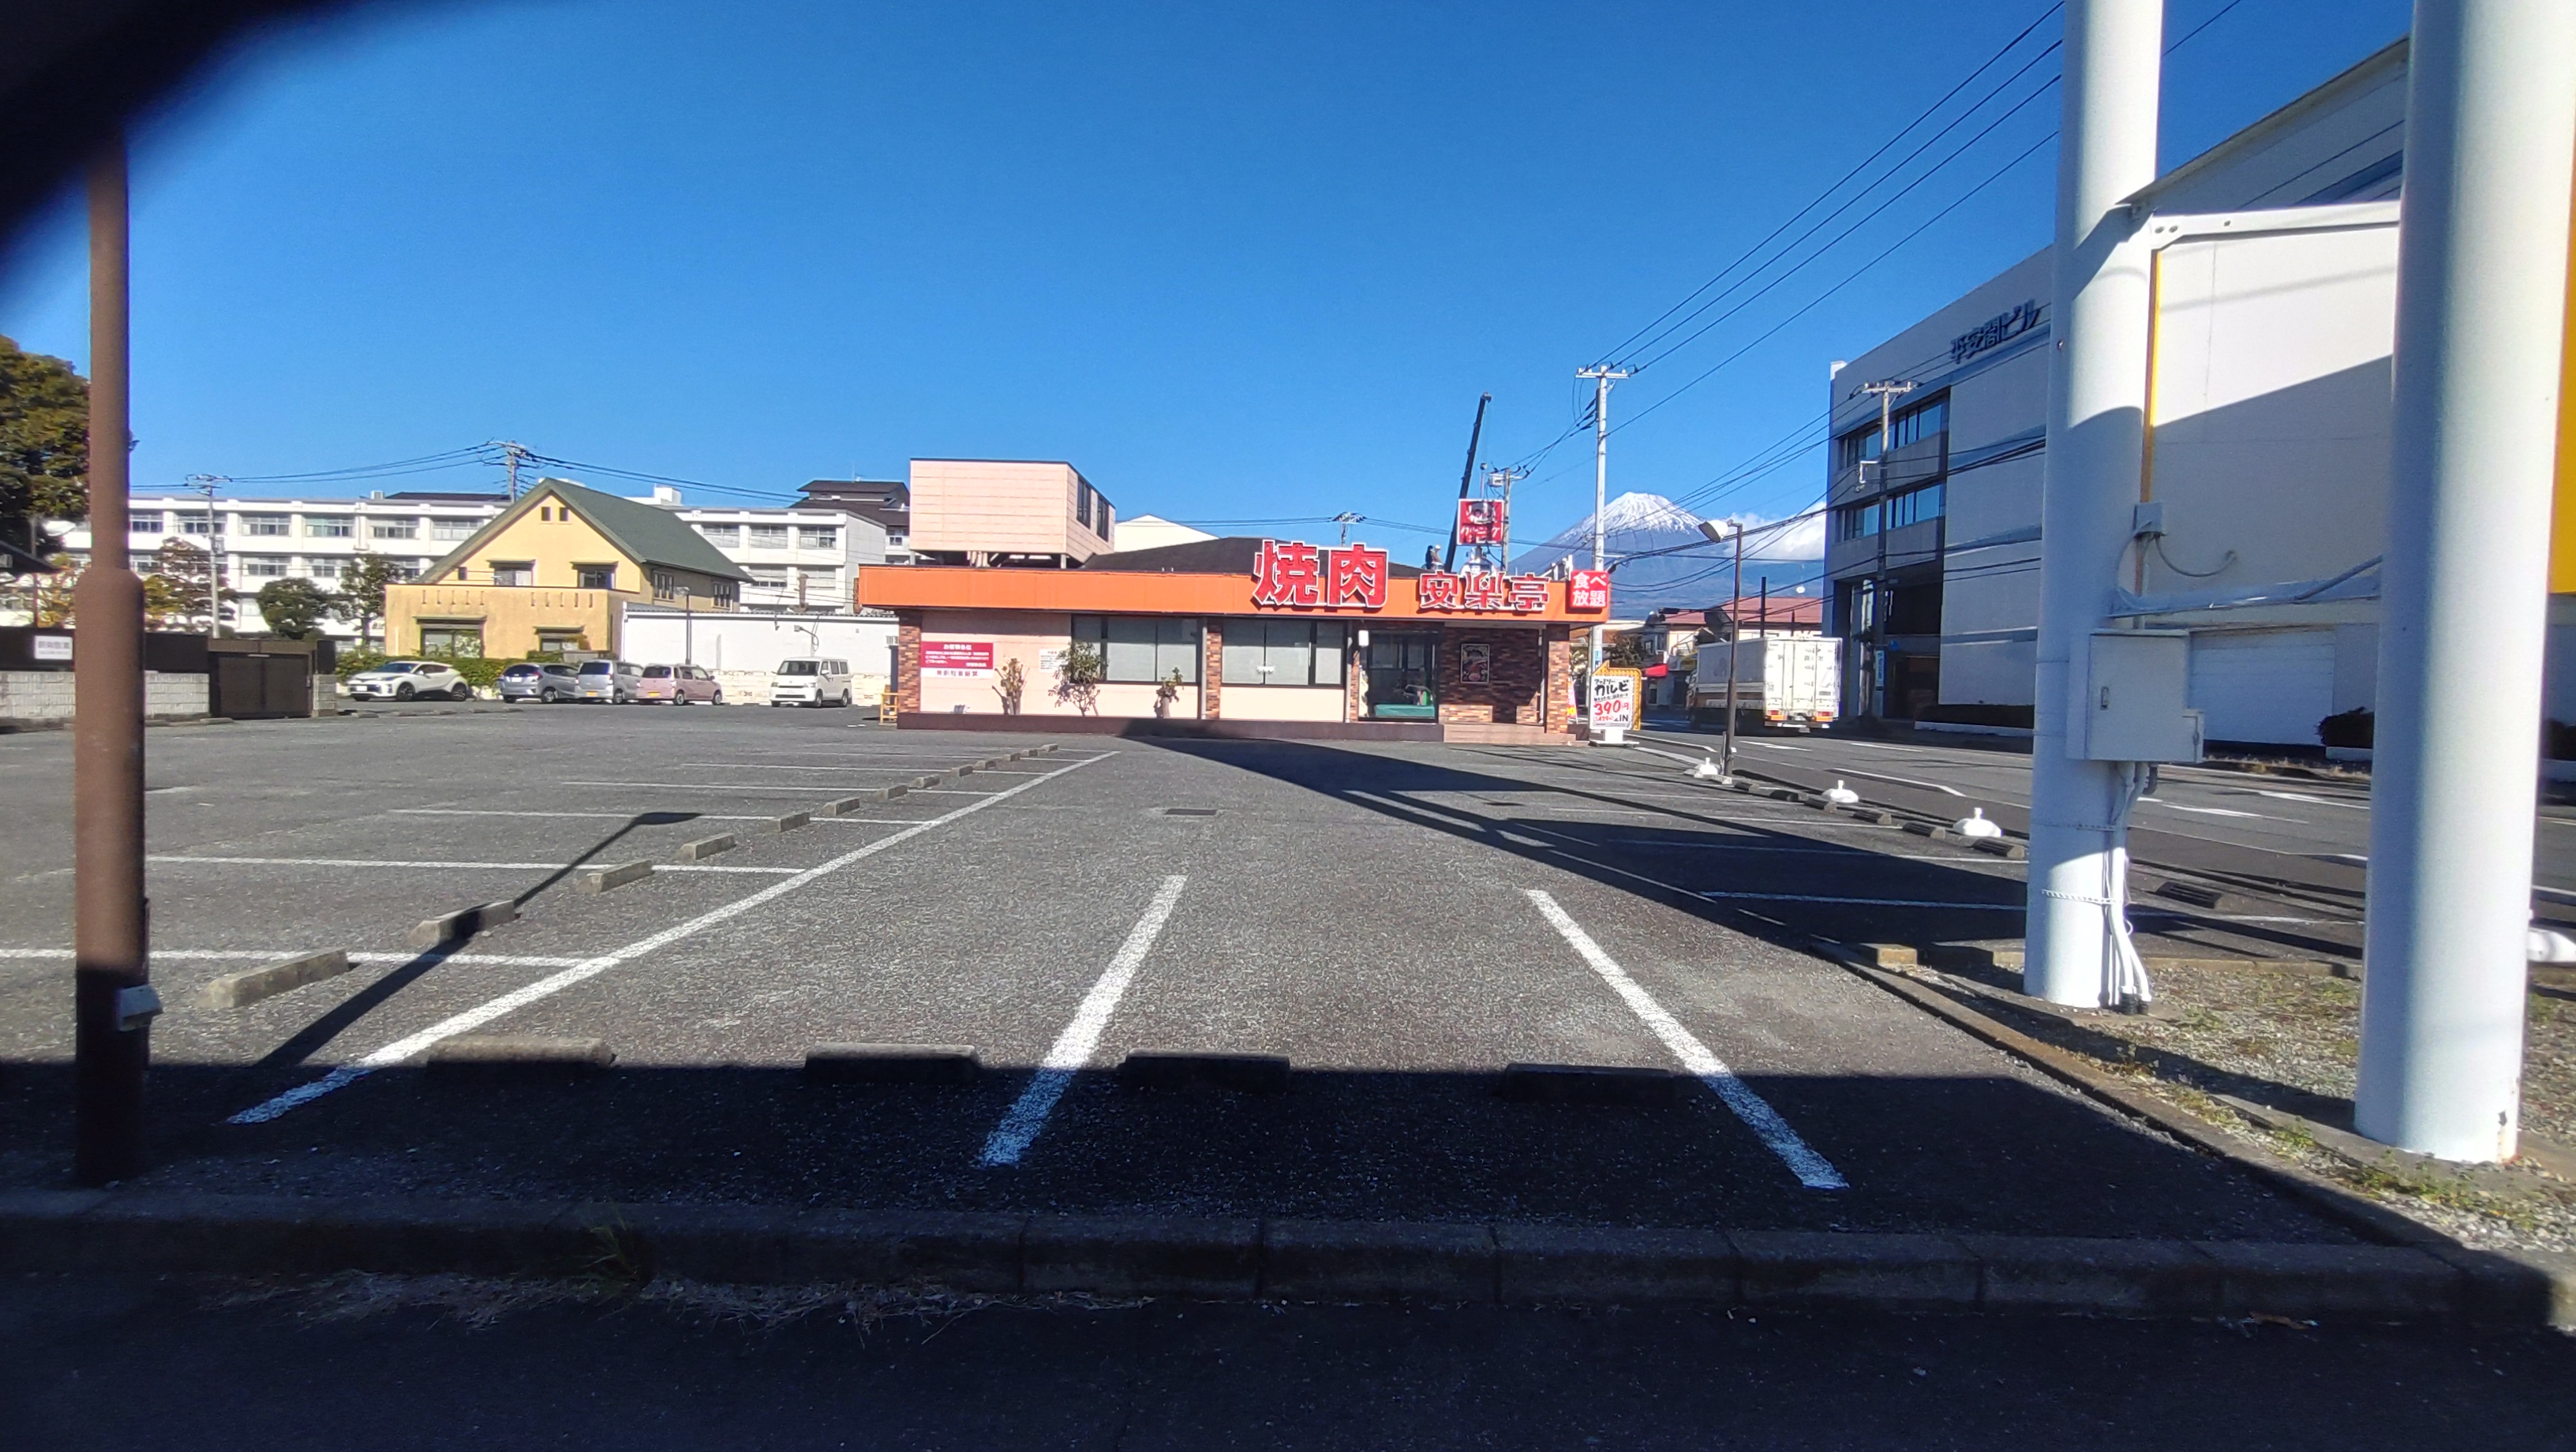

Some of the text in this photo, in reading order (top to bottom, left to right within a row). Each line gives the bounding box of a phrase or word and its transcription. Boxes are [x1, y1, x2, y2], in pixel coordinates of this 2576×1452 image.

[1252, 540, 1389, 608] 焼肉
[1573, 572, 1607, 589] 食べ
[1420, 570, 1551, 611] 安楽亭
[1573, 590, 1606, 607] 放題
[1594, 680, 1630, 696] カルビ
[1593, 699, 1629, 716] 390円
